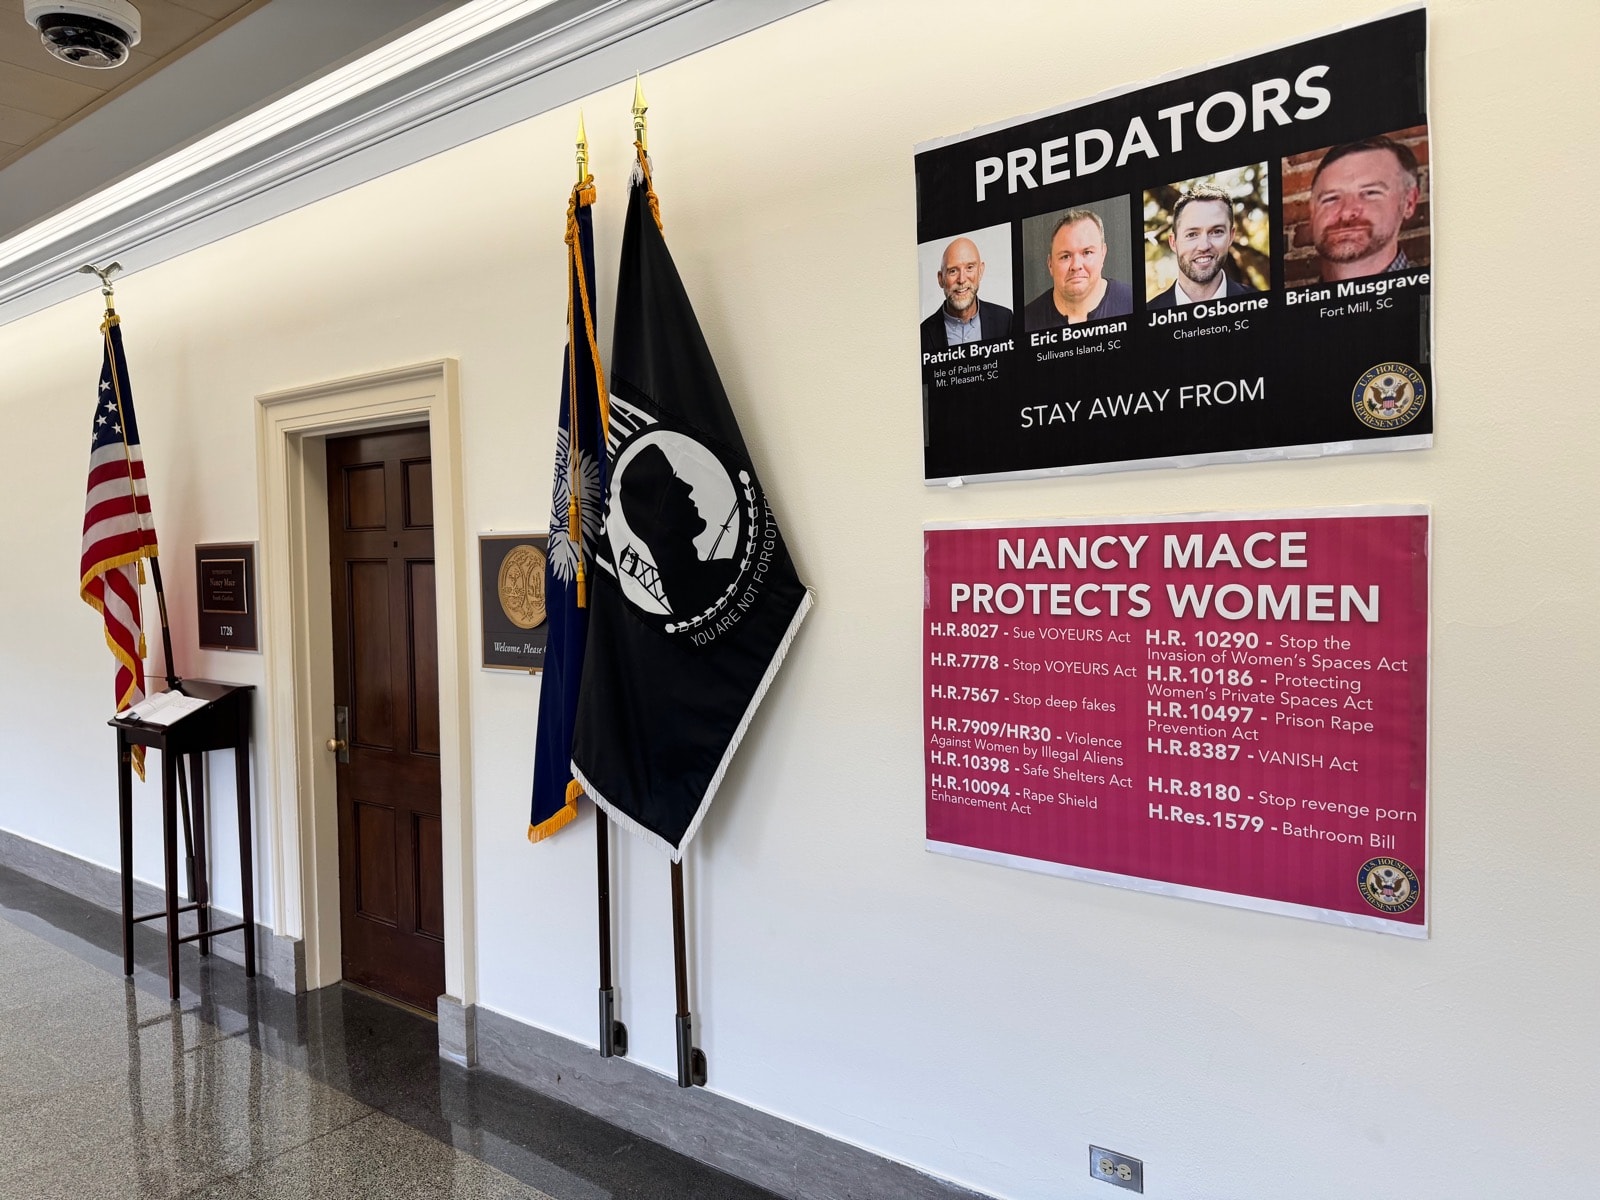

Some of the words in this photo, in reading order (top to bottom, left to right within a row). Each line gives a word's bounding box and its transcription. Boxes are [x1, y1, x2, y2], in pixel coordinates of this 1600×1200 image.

[975, 65, 1332, 202] PREDATORS
[1286, 289, 1330, 306] Brian
[1337, 273, 1430, 298] Musgrave
[1148, 309, 1187, 327] John
[1193, 298, 1268, 320] Osborne
[1320, 306, 1345, 318] Fort
[1348, 302, 1372, 314] Mill,
[1376, 298, 1393, 309] SC
[1030, 332, 1058, 347] Eric
[1062, 322, 1127, 341] Bowman
[1174, 323, 1231, 340] Charleston,
[1234, 320, 1249, 331] SC
[923, 349, 966, 365] Patrick
[970, 339, 1014, 358] Bryant
[1037, 347, 1074, 362] Sullivans
[1076, 342, 1105, 355] Island,
[1108, 340, 1121, 350] SC
[934, 368, 946, 378] Isle
[949, 366, 956, 375] of
[958, 363, 981, 374] Palms
[983, 360, 998, 370] and
[936, 378, 948, 387] Mt.
[950, 373, 985, 385] Pleasant,
[987, 371, 998, 379] SC
[1359, 374, 1375, 387] U.S.
[1376, 365, 1410, 374] HOUSE
[1409, 374, 1421, 383] OF
[1020, 400, 1081, 428] STAY
[1088, 389, 1170, 420] AWAY
[1179, 377, 1264, 409] FROM
[1355, 394, 1423, 427] REPRESENTATIVES
[998, 535, 1149, 570] NANCY
[1163, 532, 1308, 569] MACE
[690, 628, 716, 647] YOU
[715, 609, 741, 635] ARE
[738, 584, 759, 612] NOT
[951, 582, 1151, 618] PROTECTS
[1165, 584, 1380, 623] WOMEN
[220, 626, 233, 635] 1728
[930, 622, 999, 639] H.R.8027
[1013, 627, 1035, 639] Sue
[1039, 628, 1103, 641] VOYEURS
[1107, 630, 1131, 643] Act
[1146, 630, 1186, 646] H.R.
[1194, 630, 1259, 648] 10290
[1279, 634, 1318, 652] Stop
[1323, 635, 1351, 650] the
[494, 642, 521, 654] Welcome,
[523, 643, 542, 654] Please
[1148, 648, 1206, 663] Invasion
[1211, 650, 1226, 663] of
[1231, 651, 1306, 668] Women’s
[1312, 654, 1371, 671] Spaces
[1376, 657, 1408, 672] Act
[931, 652, 999, 670] H.R.7778
[1012, 658, 1041, 674] Stop
[1044, 660, 1109, 675] VOYEURS
[1113, 665, 1137, 678] Act
[1147, 665, 1253, 687] H.R.10186
[1275, 673, 1361, 694] Protecting
[931, 684, 999, 703] H.R.7567
[1013, 693, 1041, 708] Stop
[1045, 695, 1078, 711] deep
[1082, 698, 1116, 712] fakes
[1147, 684, 1216, 701] Women’s
[1222, 688, 1275, 704] Private
[1280, 692, 1338, 710] Spaces
[1343, 696, 1373, 711] Act
[1147, 701, 1254, 724] H.R.10497
[1276, 712, 1325, 729] Prison
[1331, 716, 1374, 734] Rape
[1149, 720, 1227, 737] Prevention
[1232, 726, 1259, 741] Act
[931, 716, 1051, 742] H.R.7909/HR30
[1066, 731, 1122, 748] Violence
[930, 734, 971, 749] Against
[974, 739, 1019, 755] Women
[1023, 744, 1038, 759] by
[1042, 746, 1079, 764] Illegal
[1083, 751, 1124, 766] Aliens
[1148, 738, 1241, 761] H.R.8387
[1258, 750, 1324, 768] VANISH
[1329, 757, 1359, 772] Act
[931, 750, 1009, 773] H.R.10398
[1023, 764, 1049, 778] Safe
[1053, 767, 1105, 784] Shelters
[1109, 774, 1133, 788] Act
[931, 774, 1010, 798] H.R.10094
[1023, 788, 1054, 806] Rape
[1058, 794, 1098, 810] Shield
[931, 790, 1007, 811] Enhancement
[1010, 802, 1031, 815] Act
[1149, 777, 1241, 802] H.R.8180
[1259, 791, 1296, 810] Stop
[1302, 798, 1370, 818] revenge
[1375, 807, 1417, 822] porn
[1149, 803, 1264, 833] H.Res.1579
[1282, 822, 1363, 845] Bathroom
[1370, 833, 1395, 849] Bill
[1363, 862, 1377, 872] U.S.
[1378, 858, 1406, 872] HOUSE
[1406, 871, 1416, 881] OF
[1360, 882, 1417, 911] REPRESENTATIVES
